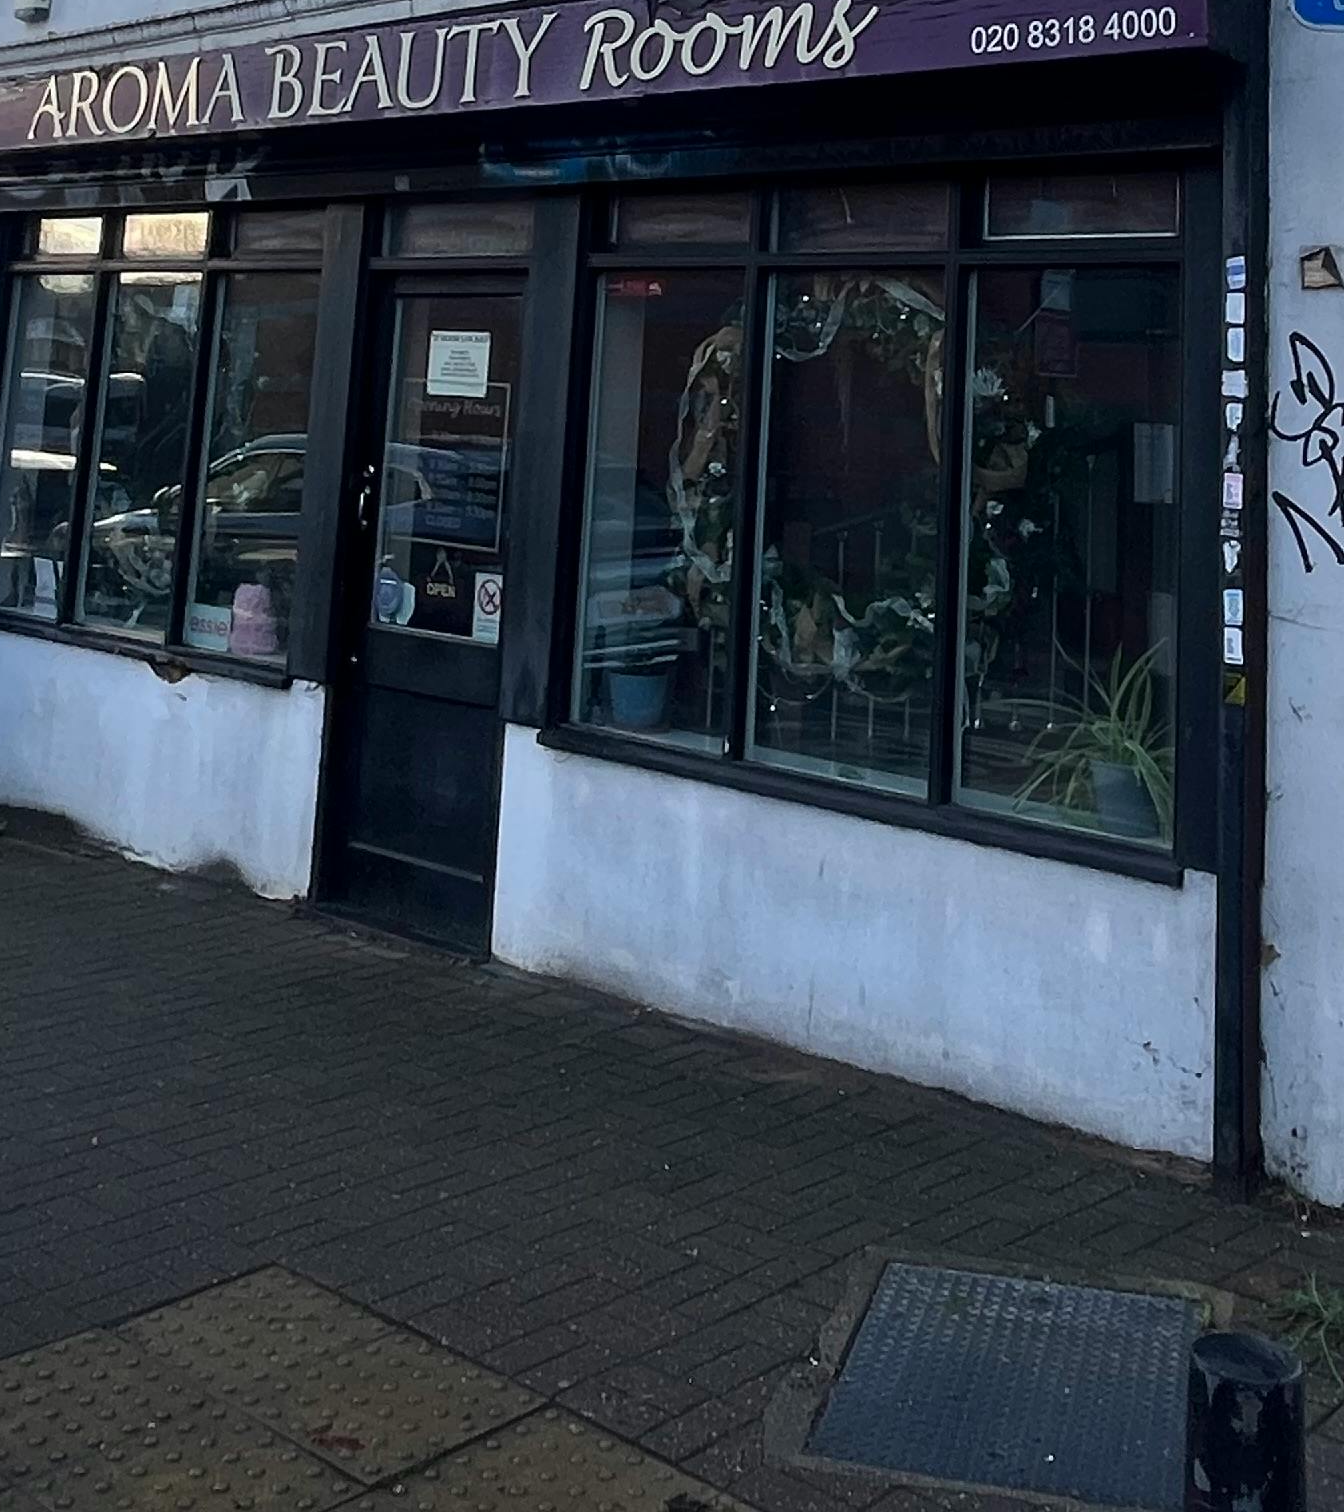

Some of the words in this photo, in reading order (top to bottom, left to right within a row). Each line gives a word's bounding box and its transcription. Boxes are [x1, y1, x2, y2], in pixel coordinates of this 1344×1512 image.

[969, 23, 1020, 55] 020
[1027, 14, 1096, 50] 8318
[1103, 6, 1177, 43] 4000
[27, 53, 245, 141] AROMA
[265, 12, 559, 120] BEAUTY
